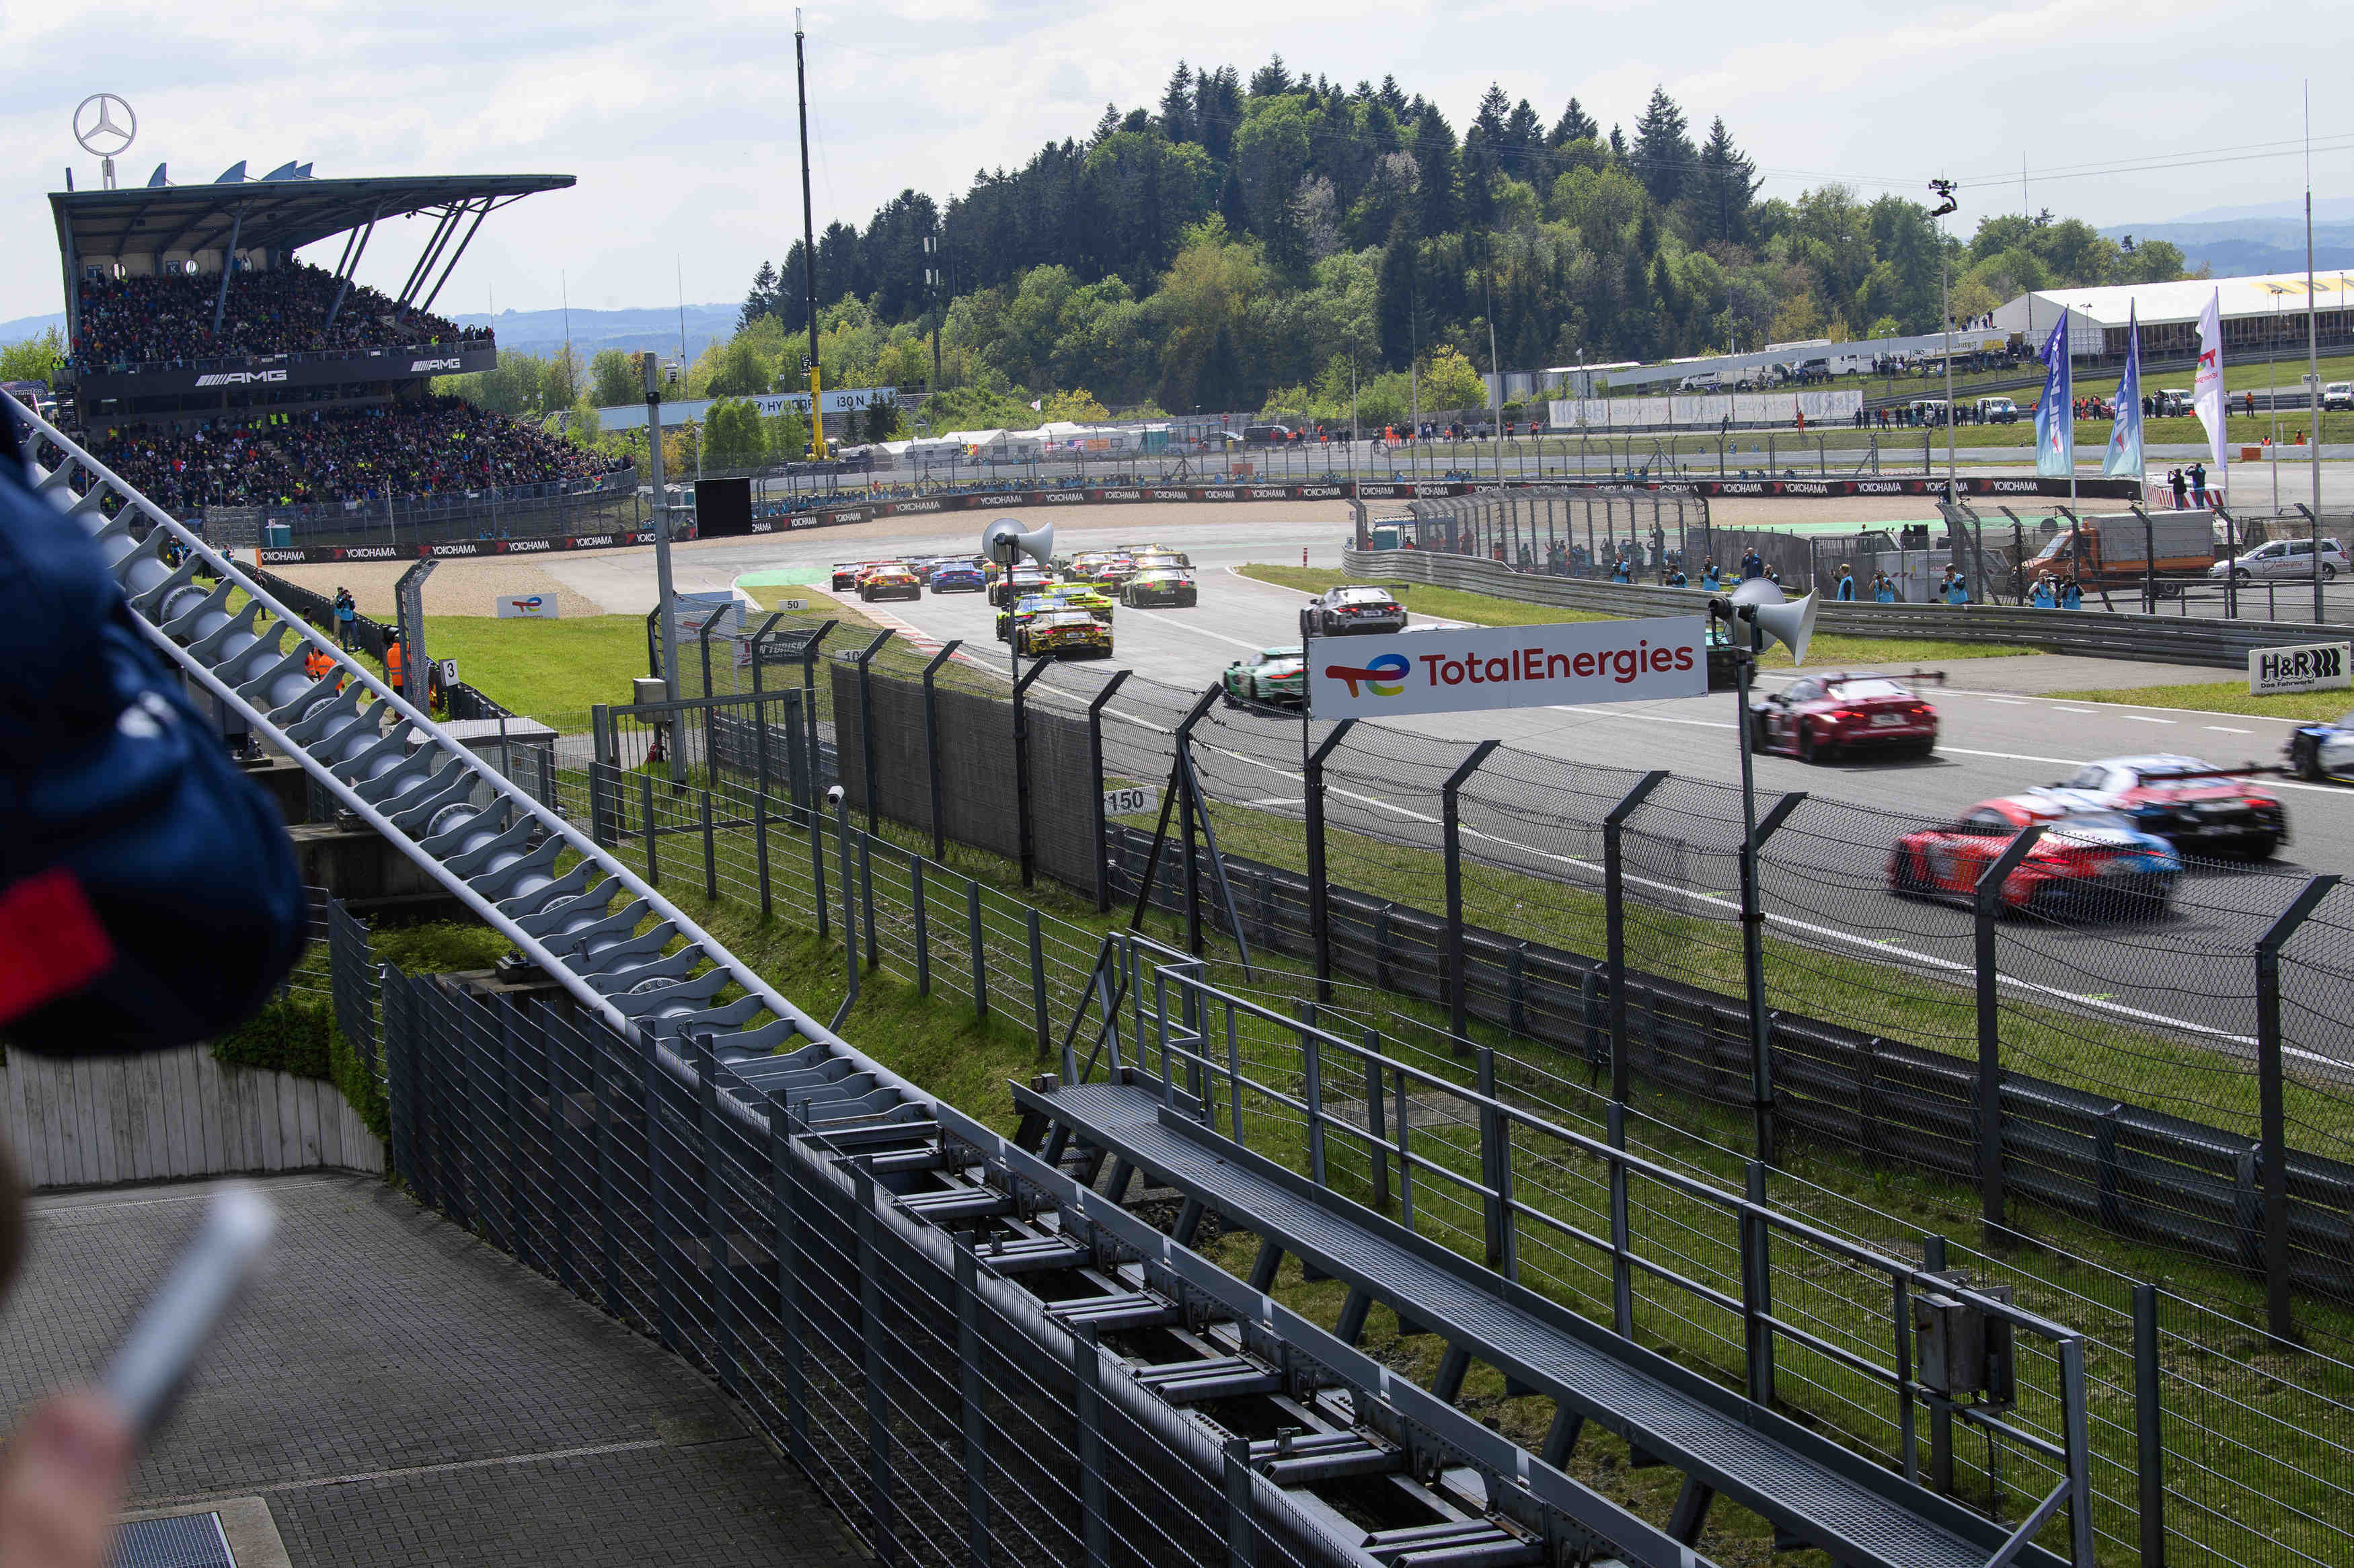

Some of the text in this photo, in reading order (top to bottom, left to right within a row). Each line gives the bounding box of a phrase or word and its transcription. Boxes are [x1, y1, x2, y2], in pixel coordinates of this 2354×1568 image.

[428, 358, 461, 370] AMG
[225, 369, 287, 385] AMG
[837, 395, 853, 407] i30
[856, 395, 865, 406] N
[1722, 483, 1762, 493] YOKOHAMA
[1785, 483, 1827, 494] YOKOHAMA
[1857, 483, 1902, 492] YOKOHAMA
[1926, 481, 1968, 492] YOKOMA
[1993, 481, 2038, 491] YOKOHAMA
[1104, 490, 1140, 500] YOKOHAMA
[1153, 490, 1188, 500] YOKOHAMA
[1205, 490, 1235, 499] YOKOHAMA
[1252, 489, 1286, 498] YOKOHAMA
[1302, 487, 1340, 496] YOKOHAMA
[1360, 487, 1394, 496] YOKOHAMA
[981, 495, 1022, 505] YOKOHAMA
[1046, 493, 1084, 502] YOKOHAMA
[895, 501, 940, 512] YOKOHAMA
[791, 516, 817, 527] YOKOHAMA
[835, 512, 862, 522] YOKOHAMA
[752, 522, 771, 533] OHAMA
[576, 536, 613, 547] YOKOHAMA
[636, 533, 656, 543] YOKO
[432, 545, 476, 555] YOKOHAMA
[509, 541, 549, 551] YOKOHAMA
[346, 548, 396, 557] YOKOHAMA
[787, 600, 799, 609] 50
[844, 650, 860, 662] 10
[1419, 639, 1694, 687] TotalEnergies
[2261, 652, 2312, 680] H&R
[447, 662, 455, 678] 3
[2277, 679, 2314, 687] Fahrwerk!
[1109, 791, 1143, 810] 150
